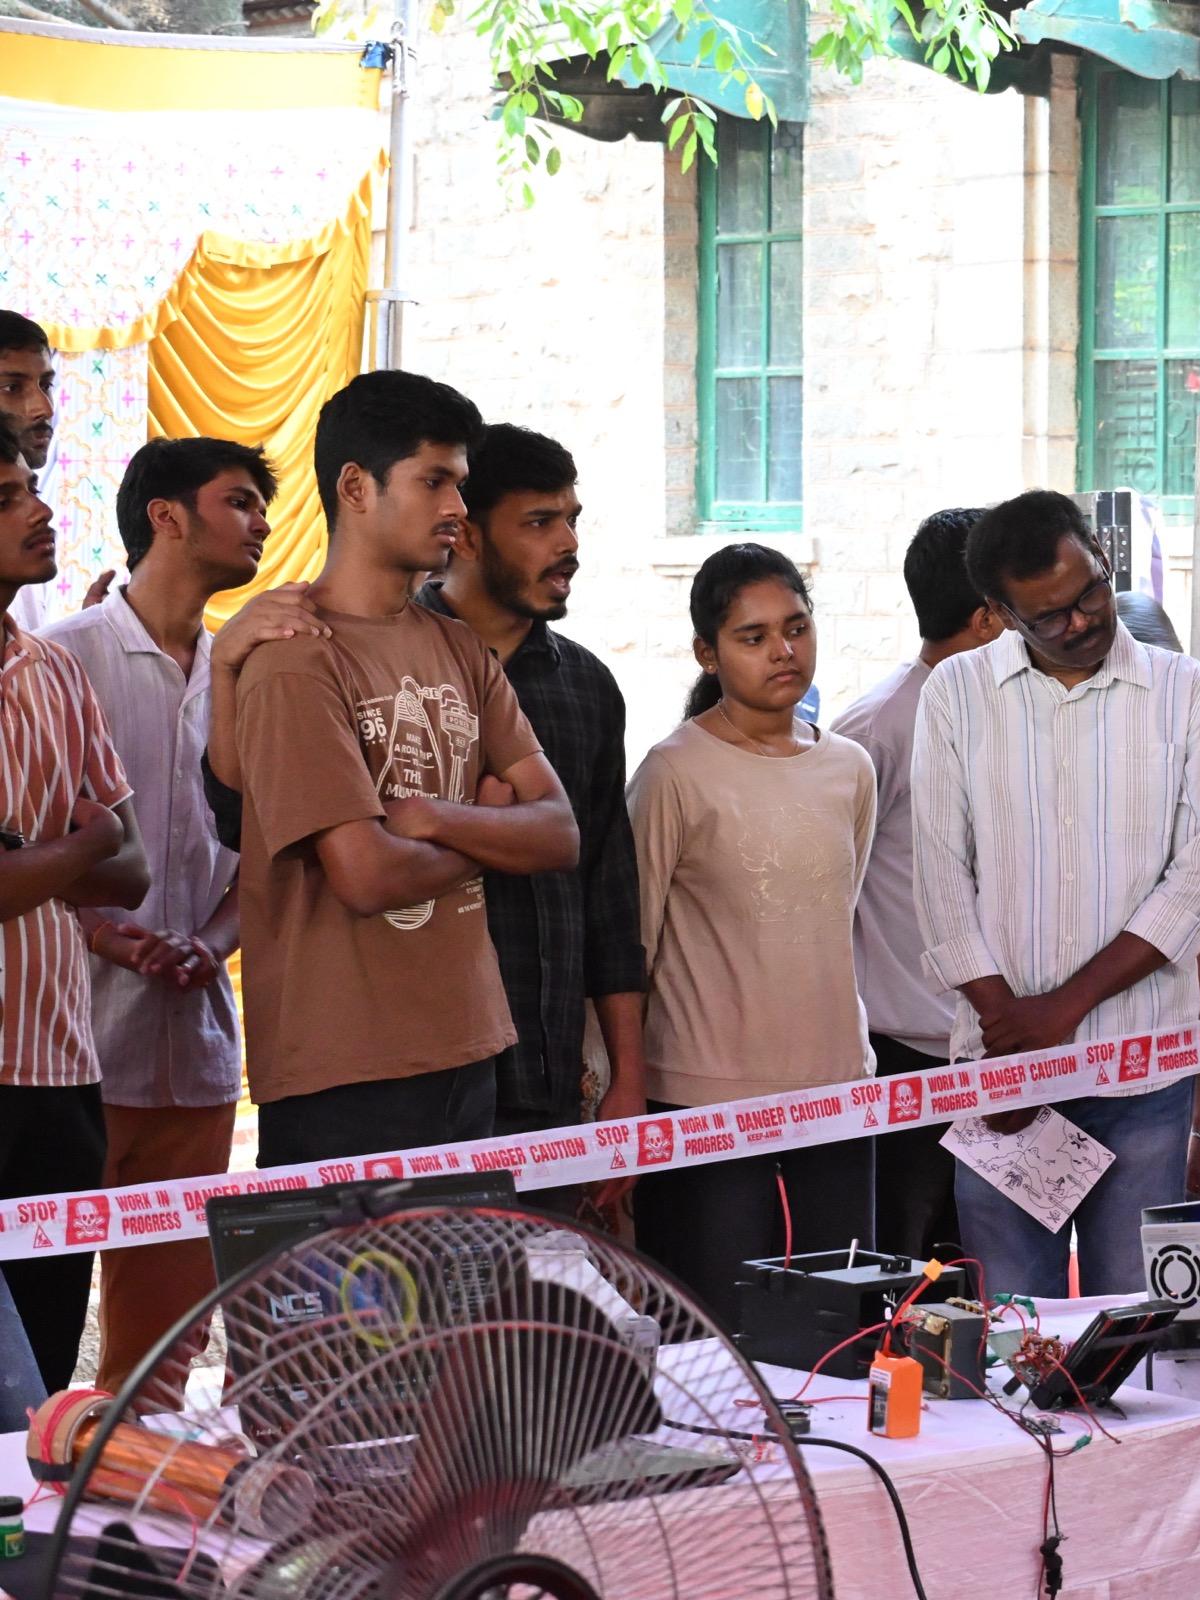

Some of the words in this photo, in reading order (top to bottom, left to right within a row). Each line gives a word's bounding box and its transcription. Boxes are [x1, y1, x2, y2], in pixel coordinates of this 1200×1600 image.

[360, 716, 387, 740] 96
[1156, 1033, 1180, 1051] WORK
[1183, 1030, 1193, 1046] IN
[1087, 1042, 1116, 1065] STOP
[1157, 1049, 1199, 1073] PROGRESS
[927, 1074, 955, 1094] WORK
[958, 1071, 970, 1087] IN
[980, 1064, 1026, 1091] DANGER
[1029, 1055, 1077, 1082] CAUTION
[850, 1083, 882, 1105] STOP
[931, 1091, 978, 1115] PROGRESS
[678, 1115, 709, 1135] WORK
[713, 1113, 725, 1129] IN
[736, 1106, 787, 1133] DANGER
[789, 1096, 842, 1123] CAUTION
[595, 1124, 630, 1148] STOP
[684, 1133, 735, 1157] PROGRESS
[408, 1156, 443, 1174] WORK
[445, 1152, 460, 1169] IN
[471, 1147, 527, 1172] DANGER
[529, 1137, 588, 1163] CAUTION
[318, 1163, 355, 1186] STOP
[17, 1200, 58, 1224] STOP
[115, 1193, 151, 1213] WORK
[156, 1190, 170, 1208] IN
[122, 1211, 181, 1236] PROGRESS
